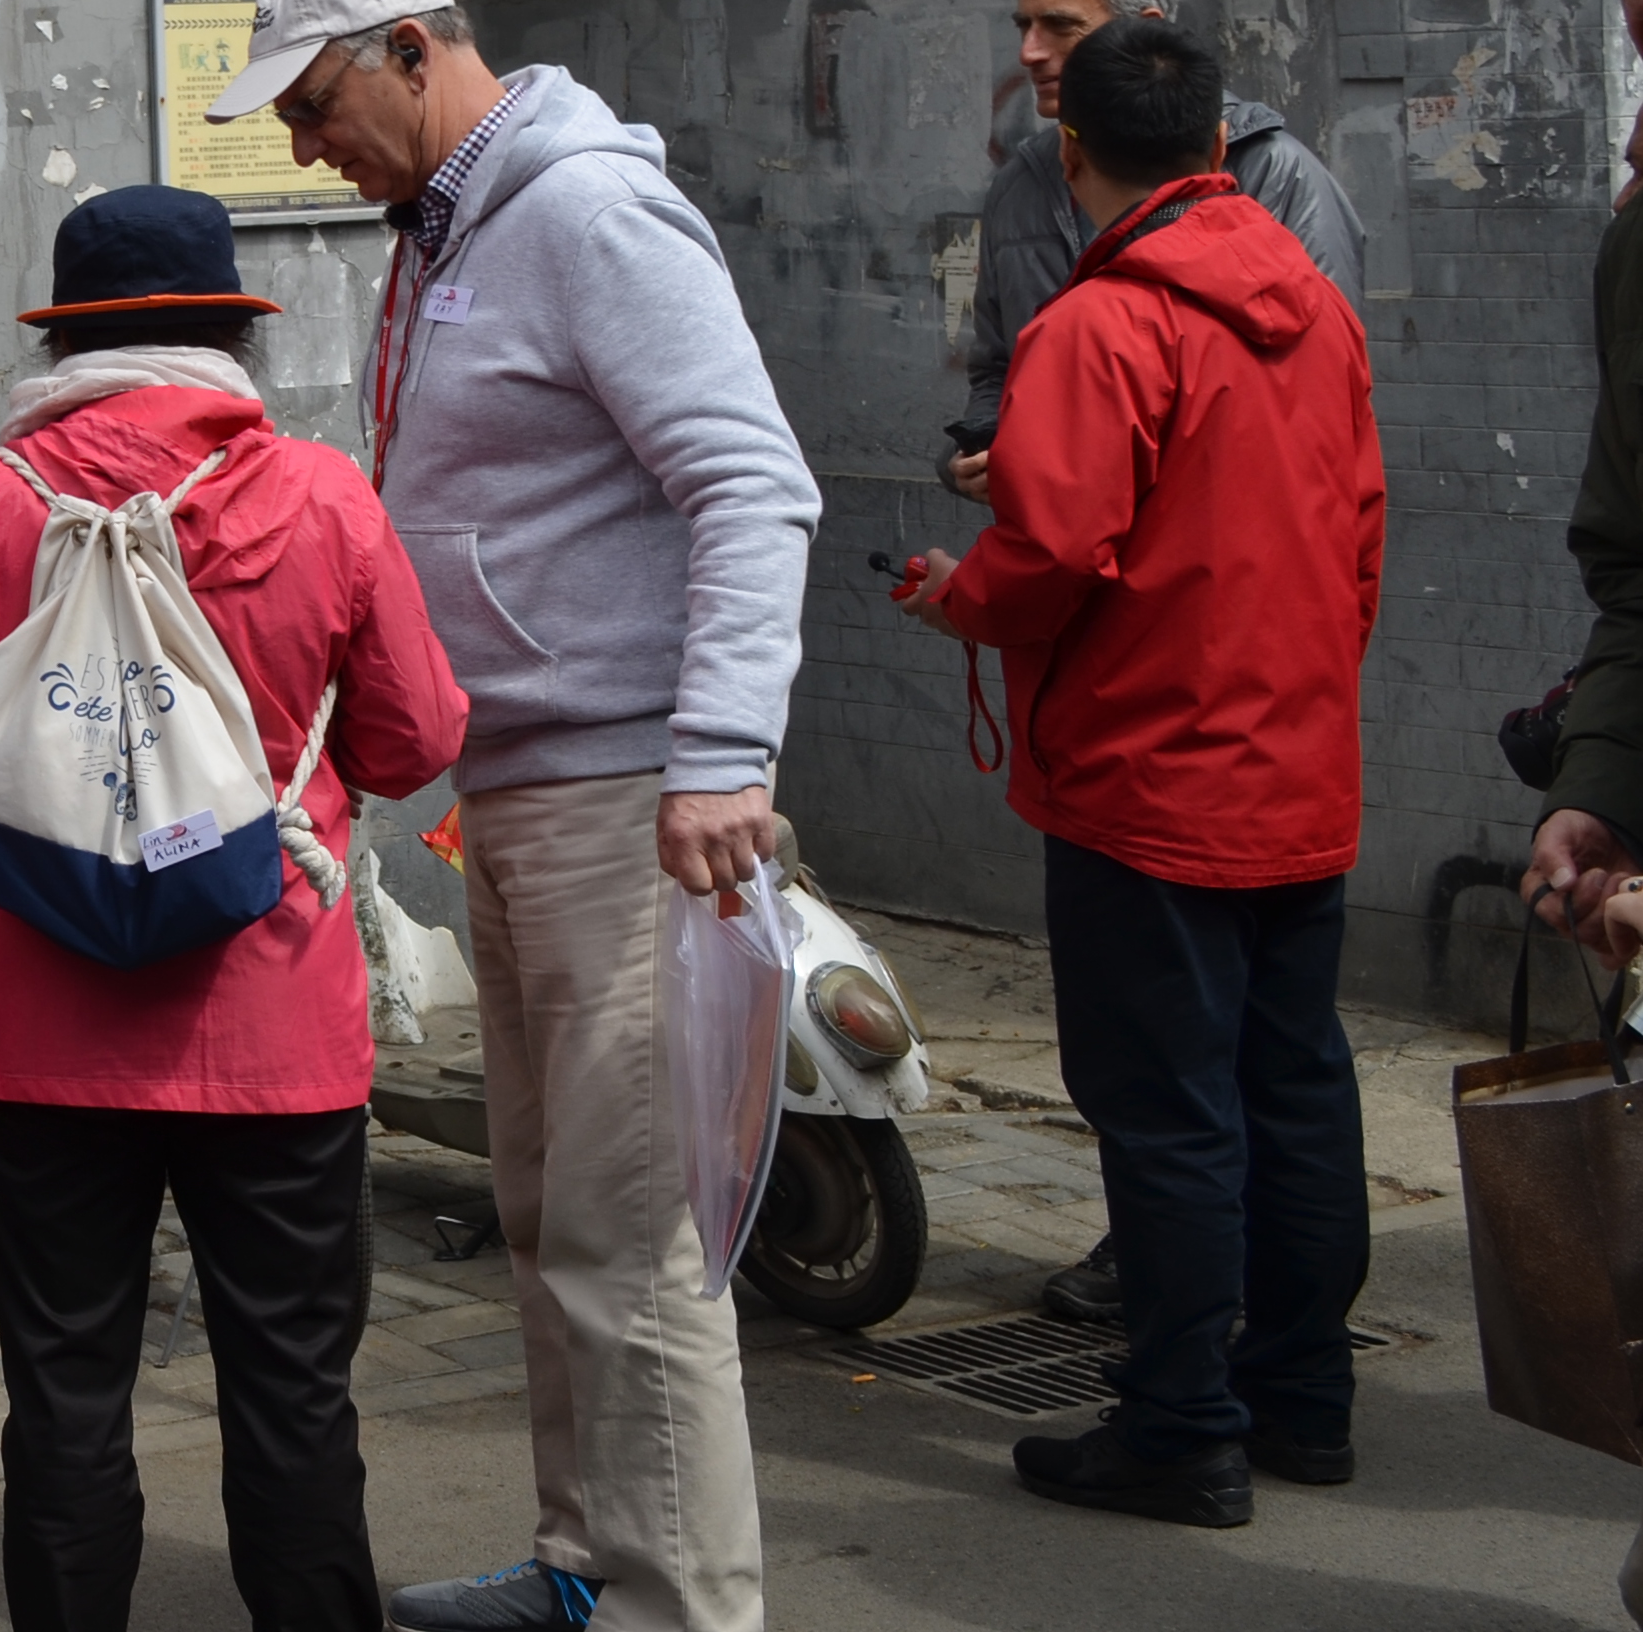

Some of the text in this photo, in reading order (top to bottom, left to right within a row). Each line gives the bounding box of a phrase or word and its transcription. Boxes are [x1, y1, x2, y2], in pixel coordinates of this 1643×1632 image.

[74, 696, 117, 722] été
[68, 722, 117, 750] SOMMER
[153, 837, 202, 863] ALINA
